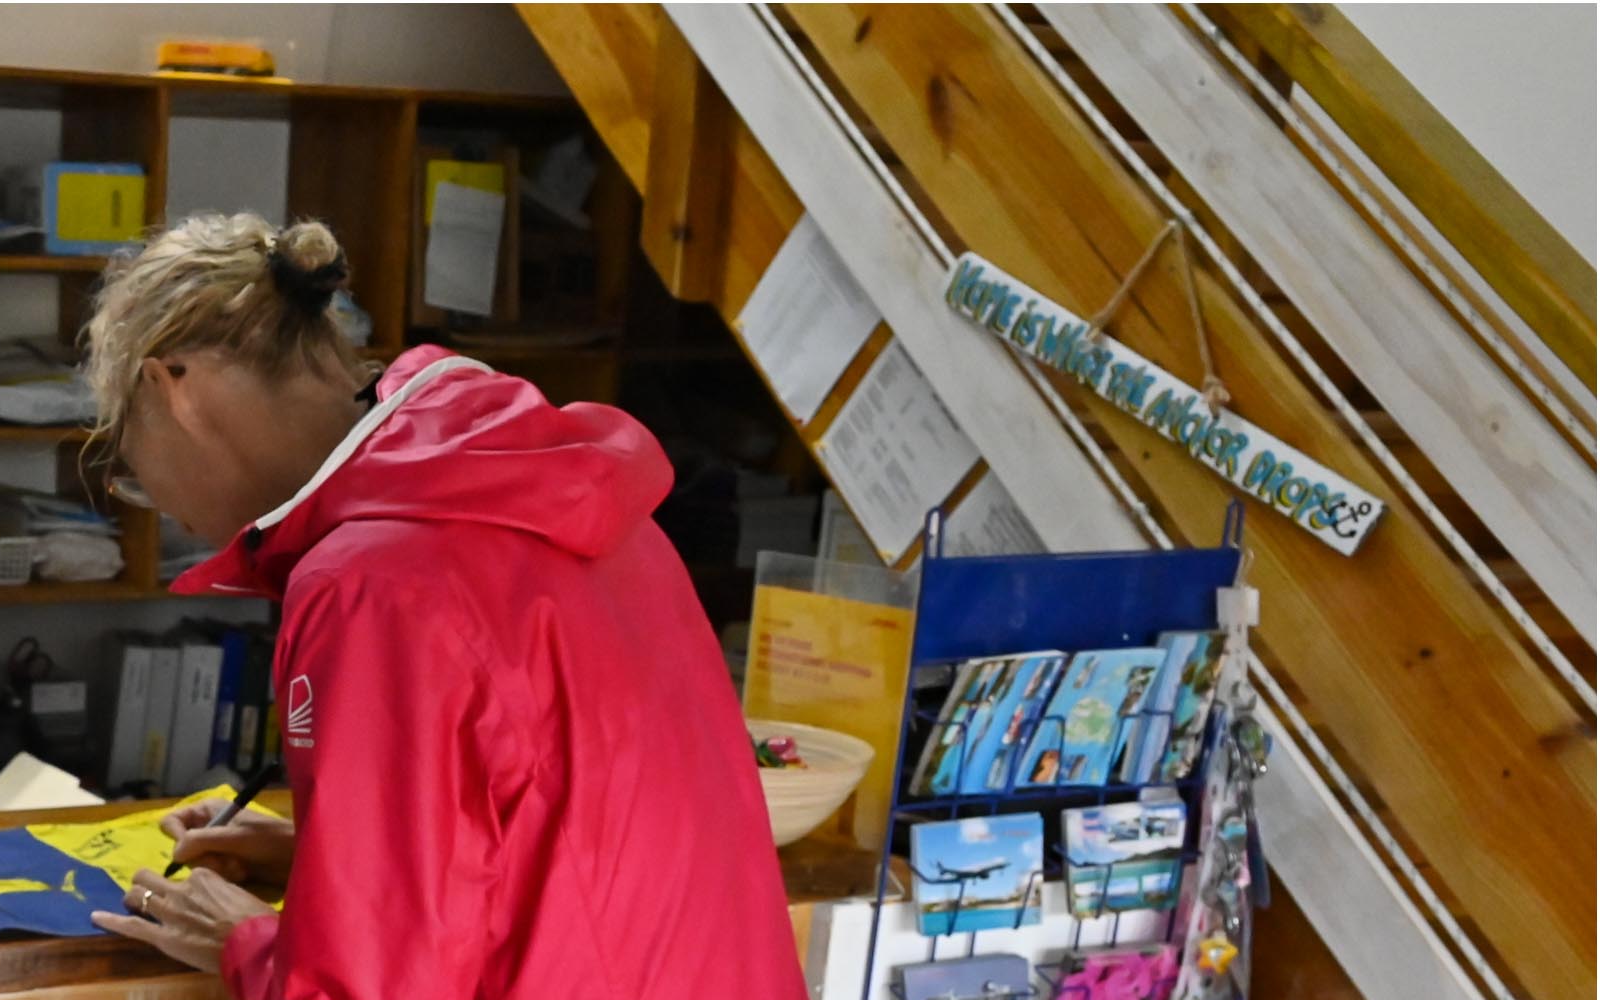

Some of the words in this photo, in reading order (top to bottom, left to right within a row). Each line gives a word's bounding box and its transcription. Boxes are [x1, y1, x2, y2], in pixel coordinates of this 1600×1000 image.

[946, 260, 1022, 334] HOME
[1105, 362, 1156, 413] THE
[1143, 388, 1249, 478] ANCHOR
[1244, 448, 1346, 530] DROPS
